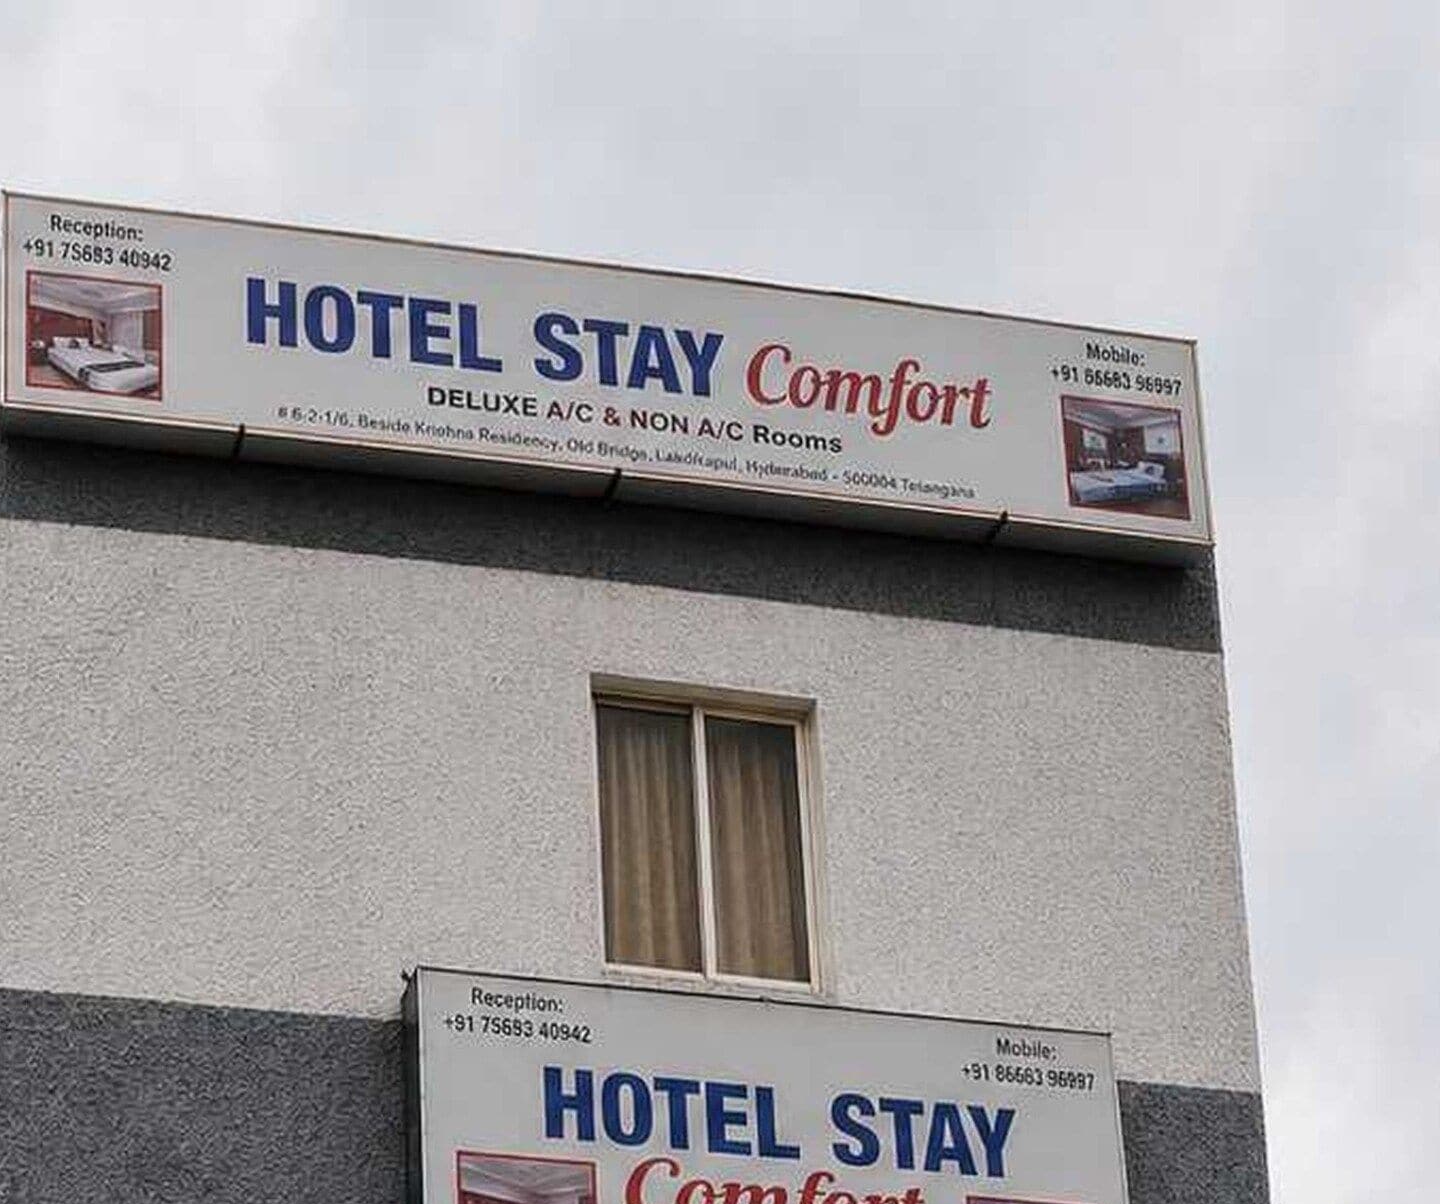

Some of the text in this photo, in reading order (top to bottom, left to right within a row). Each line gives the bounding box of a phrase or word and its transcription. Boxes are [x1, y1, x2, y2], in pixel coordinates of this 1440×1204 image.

[49, 214, 144, 242] Reception:
[23, 238, 54, 258] +91
[119, 248, 172, 272] 40942
[245, 276, 993, 437] HOTEL STAY Comfort
[1085, 342, 1146, 367] Mobile:
[1051, 364, 1079, 383] +91
[358, 413, 410, 432] Beside
[567, 437, 594, 453] Old
[427, 386, 843, 454] DELUXE A/C & NON A/C Rooms
[471, 986, 564, 1013] Reception:
[443, 1013, 474, 1033] +91
[539, 1021, 592, 1044] 40942
[996, 1037, 1057, 1061] Mobile:
[962, 1062, 990, 1082] +91
[543, 1065, 1016, 1178] HOTEL STAY
